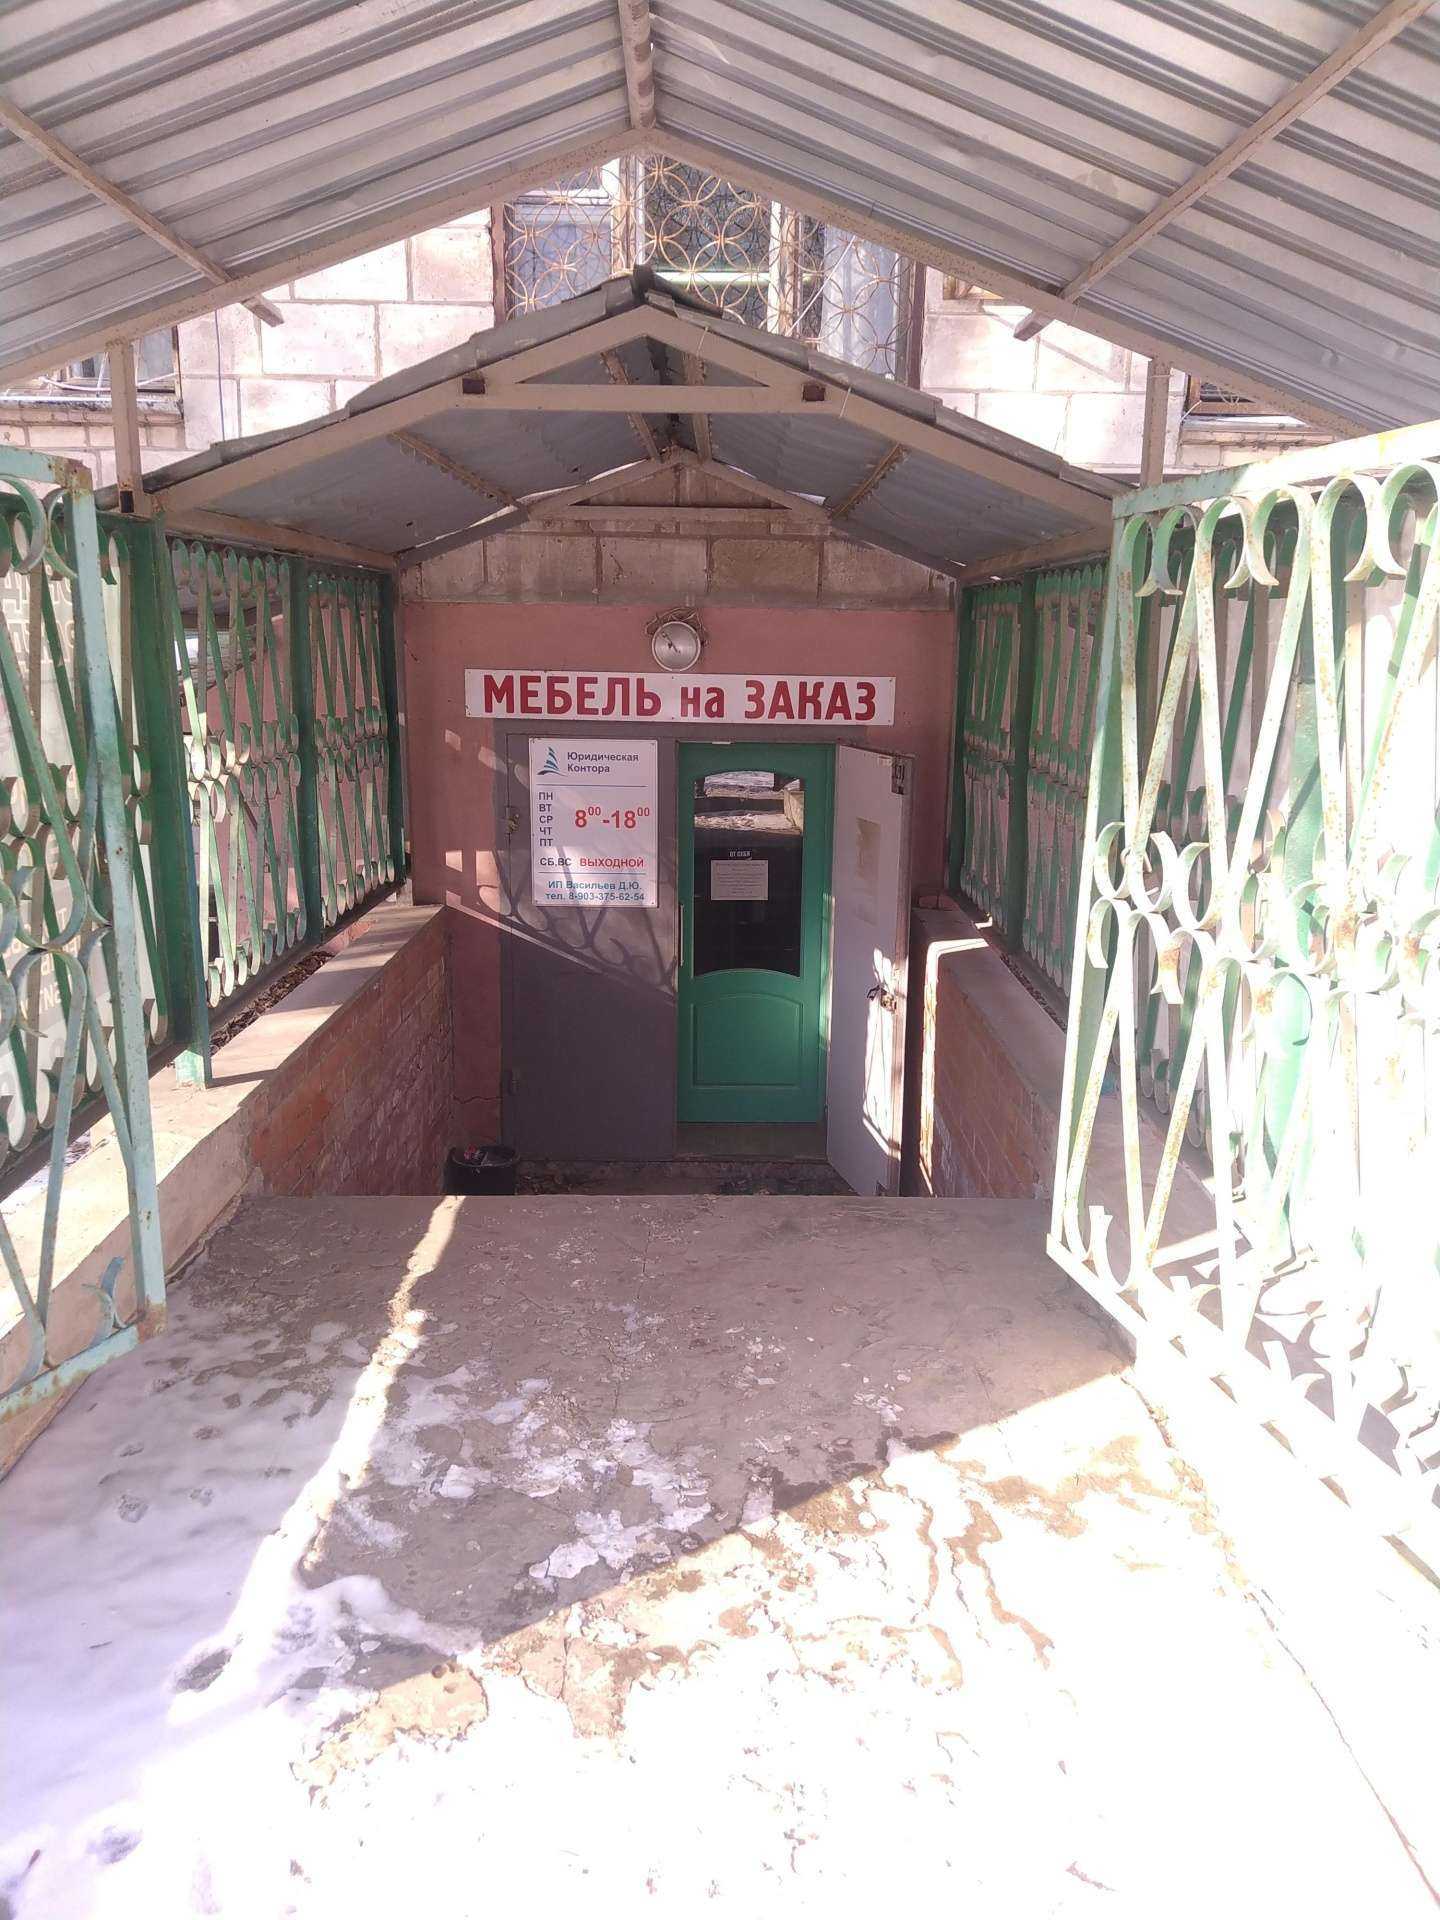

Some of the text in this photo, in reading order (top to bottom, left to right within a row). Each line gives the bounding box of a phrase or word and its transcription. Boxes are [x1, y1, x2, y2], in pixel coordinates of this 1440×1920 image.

[484, 675, 876, 720] МЕБЕЛЬ на ЗАКАЗ
[568, 752, 639, 762] Юридическая
[568, 764, 610, 774] Контора
[539, 792, 553, 800] ПН
[539, 804, 551, 812] ВТ
[540, 827, 552, 835] ЧТ
[580, 857, 644, 868] ВЫХОДНОЙ
[567, 881, 615, 890] Васильев
[618, 882, 641, 890] Д.Ю.
[569, 892, 644, 901] 8-903-375-62-54
